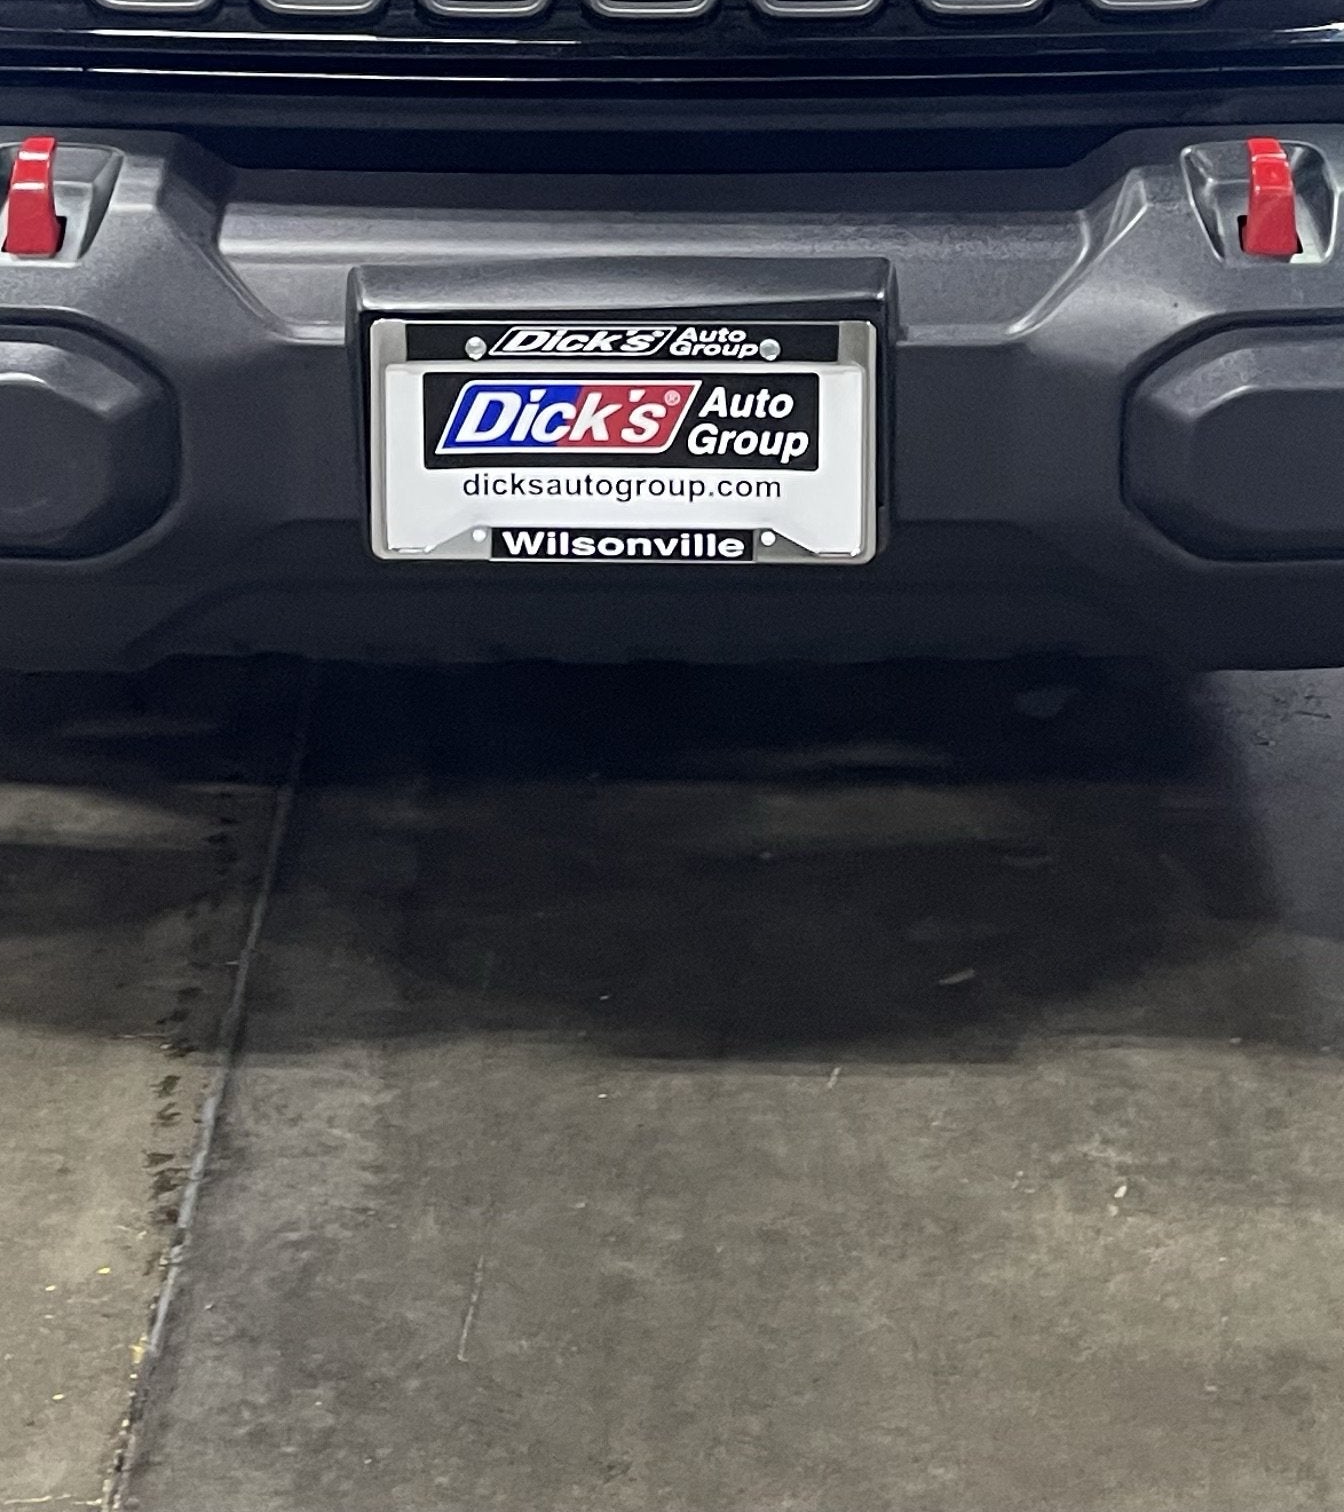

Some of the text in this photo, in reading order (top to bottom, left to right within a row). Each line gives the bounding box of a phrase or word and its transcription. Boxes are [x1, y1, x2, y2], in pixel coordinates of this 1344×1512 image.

[676, 327, 747, 343] Auto
[669, 342, 758, 359] Group
[698, 387, 794, 419] Auto
[687, 423, 809, 464] Group
[462, 473, 782, 502] dicksautogroup.com
[502, 531, 746, 557] Wilsonville
